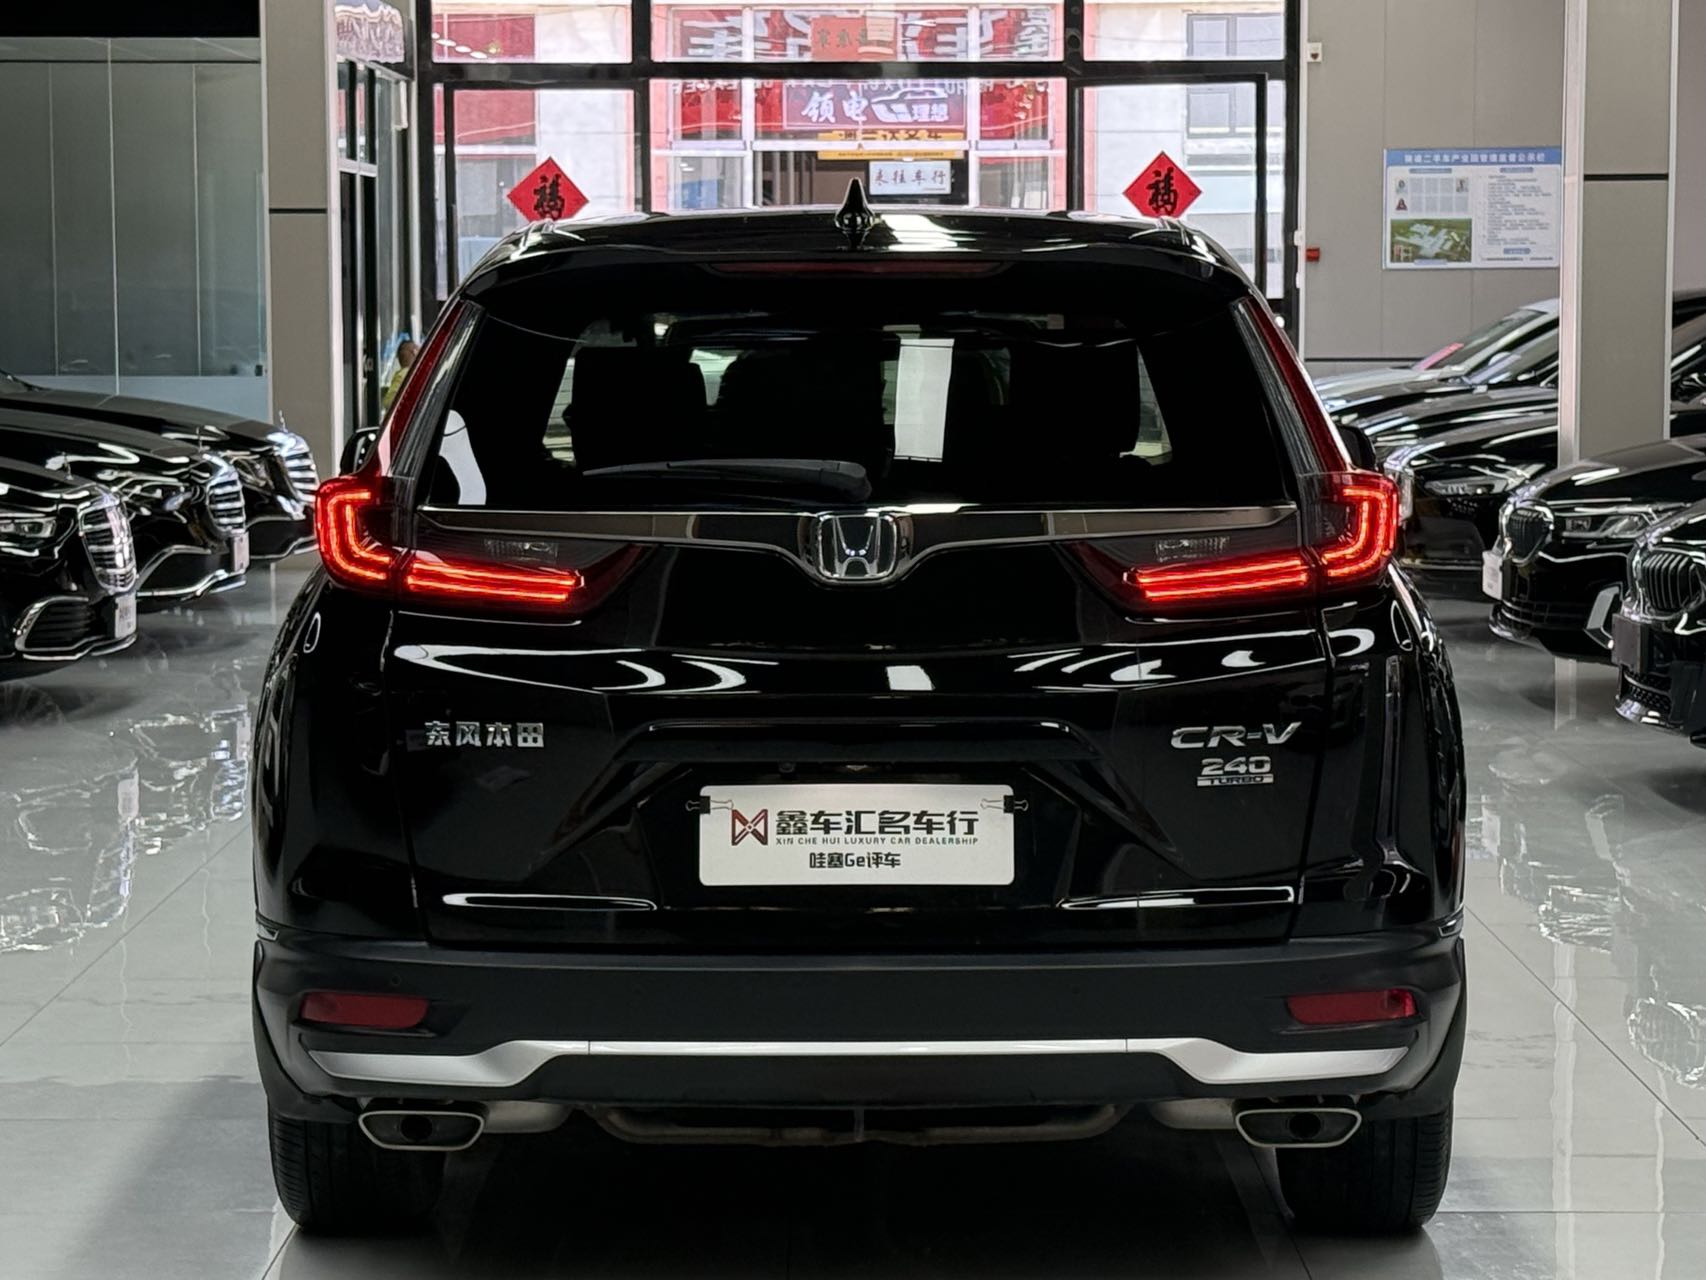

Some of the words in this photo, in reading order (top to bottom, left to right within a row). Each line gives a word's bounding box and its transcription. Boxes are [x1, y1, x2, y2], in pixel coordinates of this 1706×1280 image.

[533, 173, 566, 221] 福
[1146, 167, 1178, 216] 福
[424, 720, 545, 748] 东风本田
[1171, 721, 1302, 749] CR-V
[1201, 756, 1271, 775] 240
[1209, 776, 1264, 785] TURBO
[776, 810, 979, 835] 鑫车汇名车行
[776, 837, 794, 845] XIN
[798, 837, 817, 845] CHE
[822, 837, 840, 845] HUI
[844, 837, 886, 845] LUXURY
[890, 837, 911, 845] CAR
[915, 837, 978, 845] DEALERSHIP
[809, 852, 901, 869] 哇塞Ge评车
